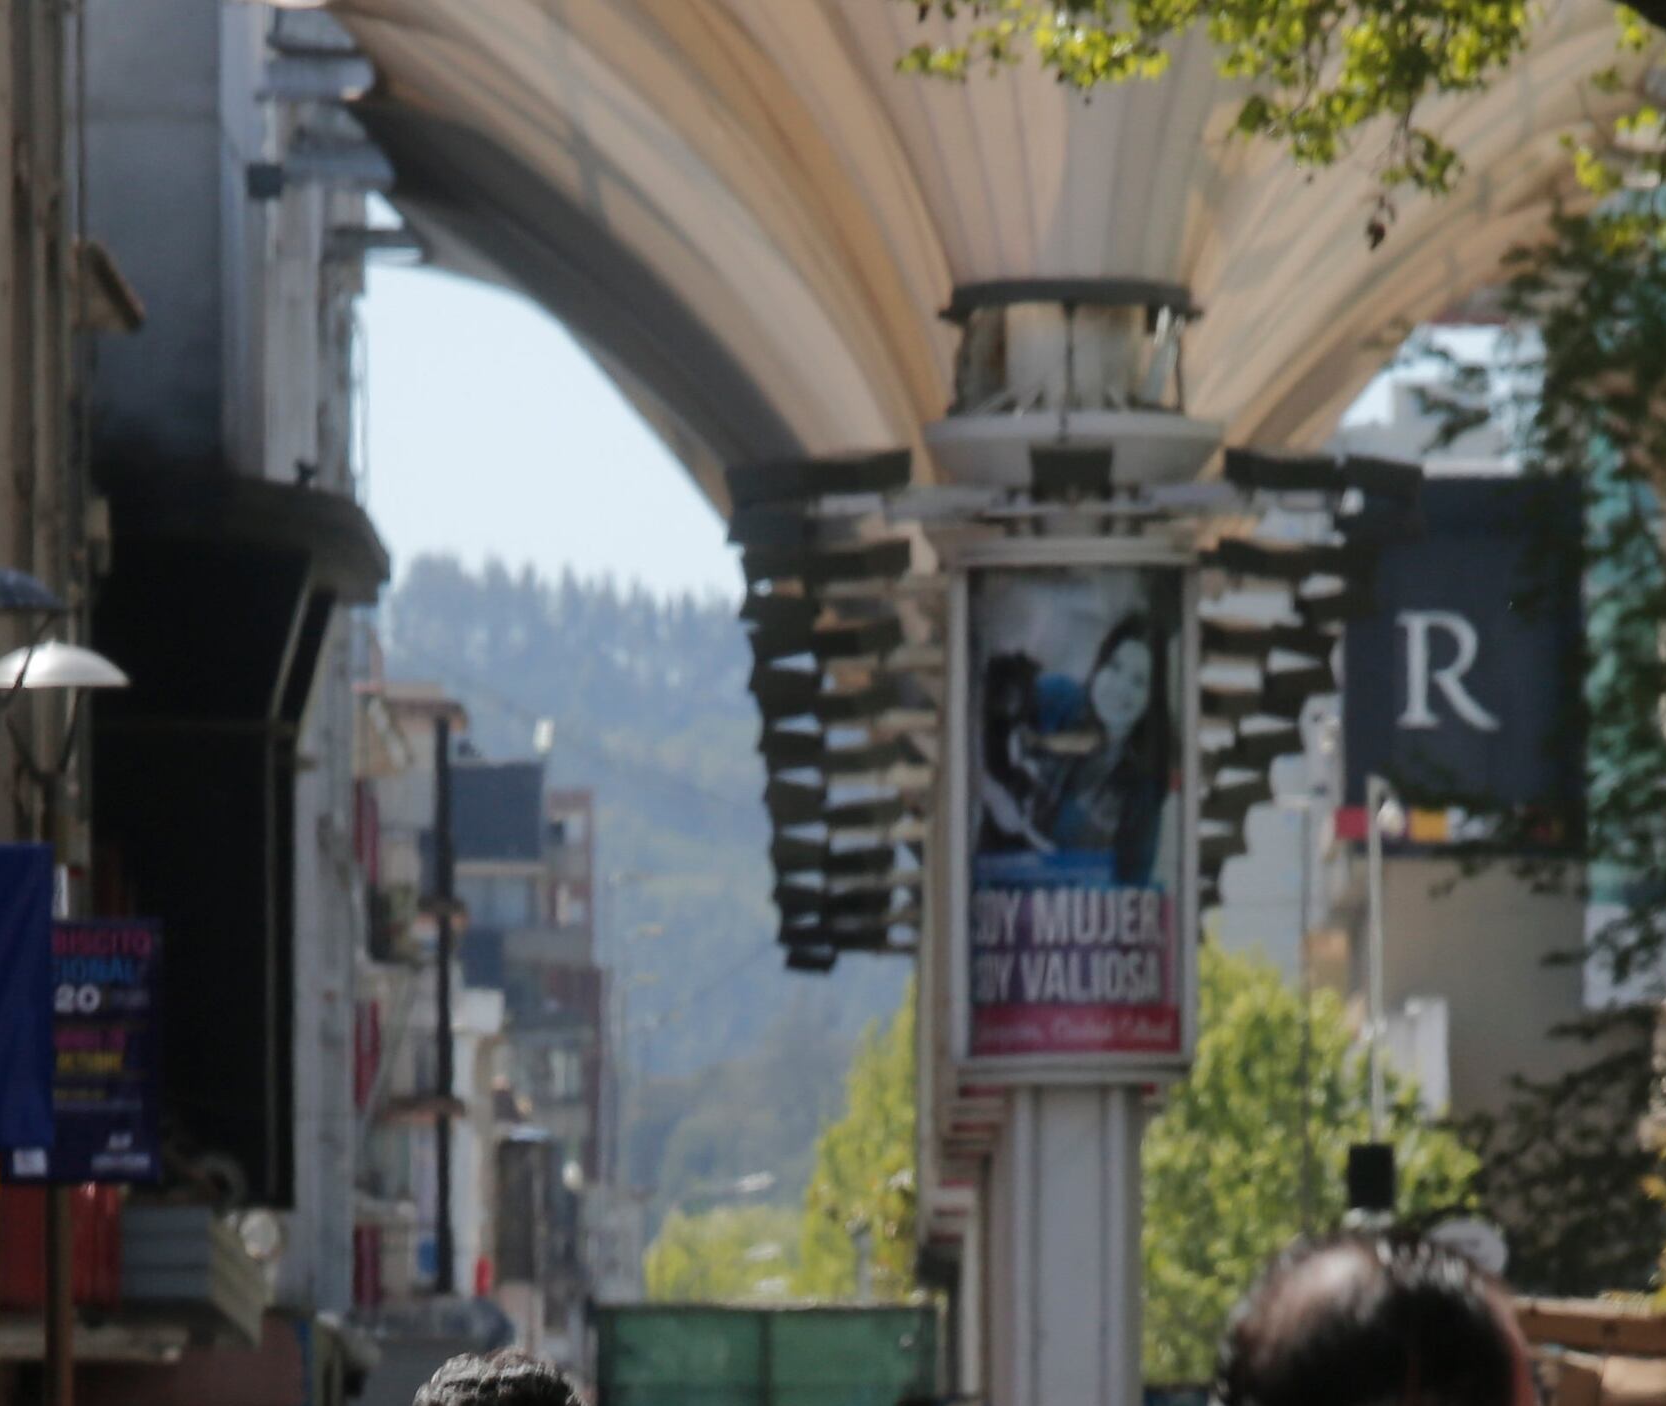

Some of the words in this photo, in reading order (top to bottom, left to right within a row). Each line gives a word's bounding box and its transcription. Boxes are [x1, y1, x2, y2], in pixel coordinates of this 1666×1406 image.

[1397, 609, 1499, 731] R
[1031, 885, 1164, 946] MUJER
[1019, 949, 1161, 1003] VALIOSA
